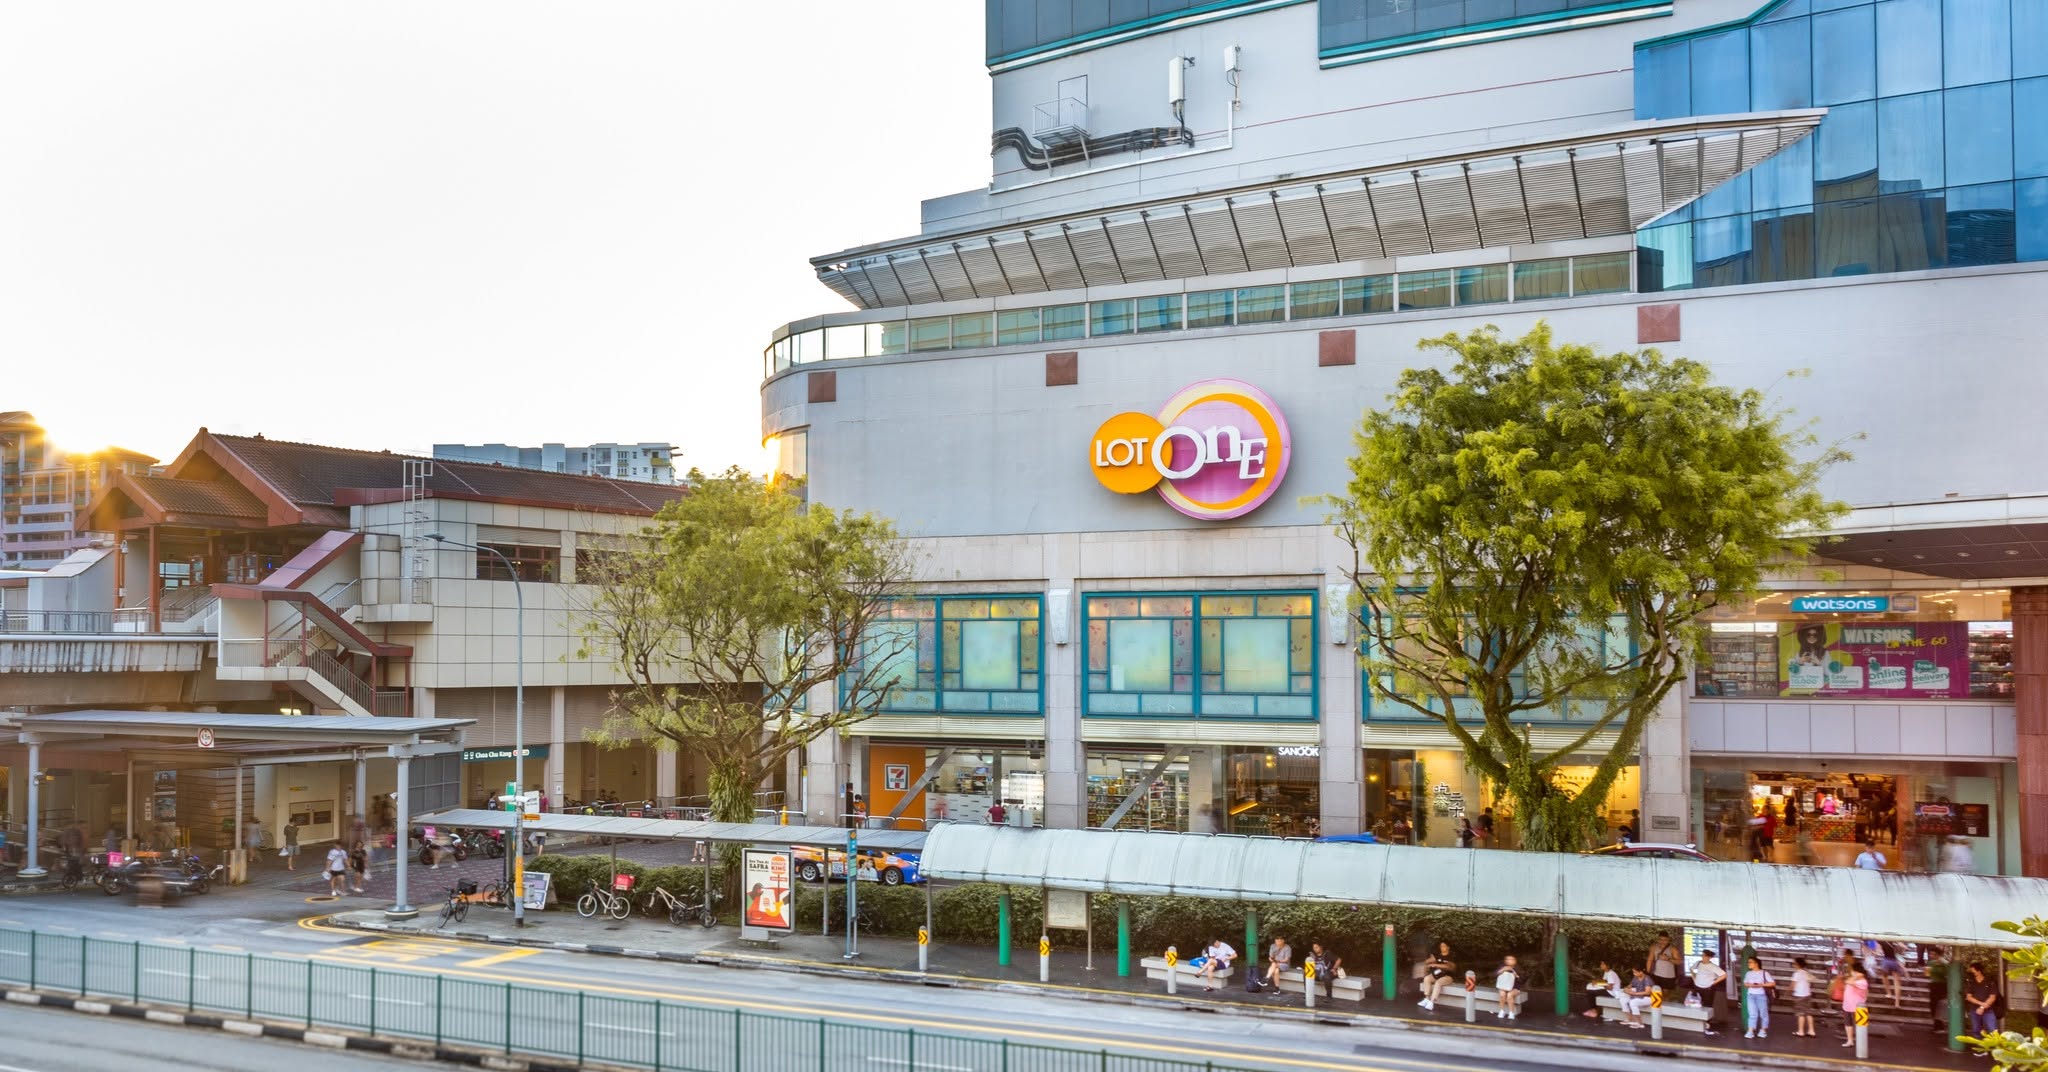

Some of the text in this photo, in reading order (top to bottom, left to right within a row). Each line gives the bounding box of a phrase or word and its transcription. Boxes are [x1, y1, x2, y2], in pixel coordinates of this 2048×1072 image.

[1095, 437, 1149, 467] LOT
[1801, 599, 1877, 610] watsons
[1844, 628, 1911, 643] WATSONS
[1931, 636, 1947, 646] GO
[1869, 668, 1906, 680] online
[1278, 746, 1319, 757] SANOOK
